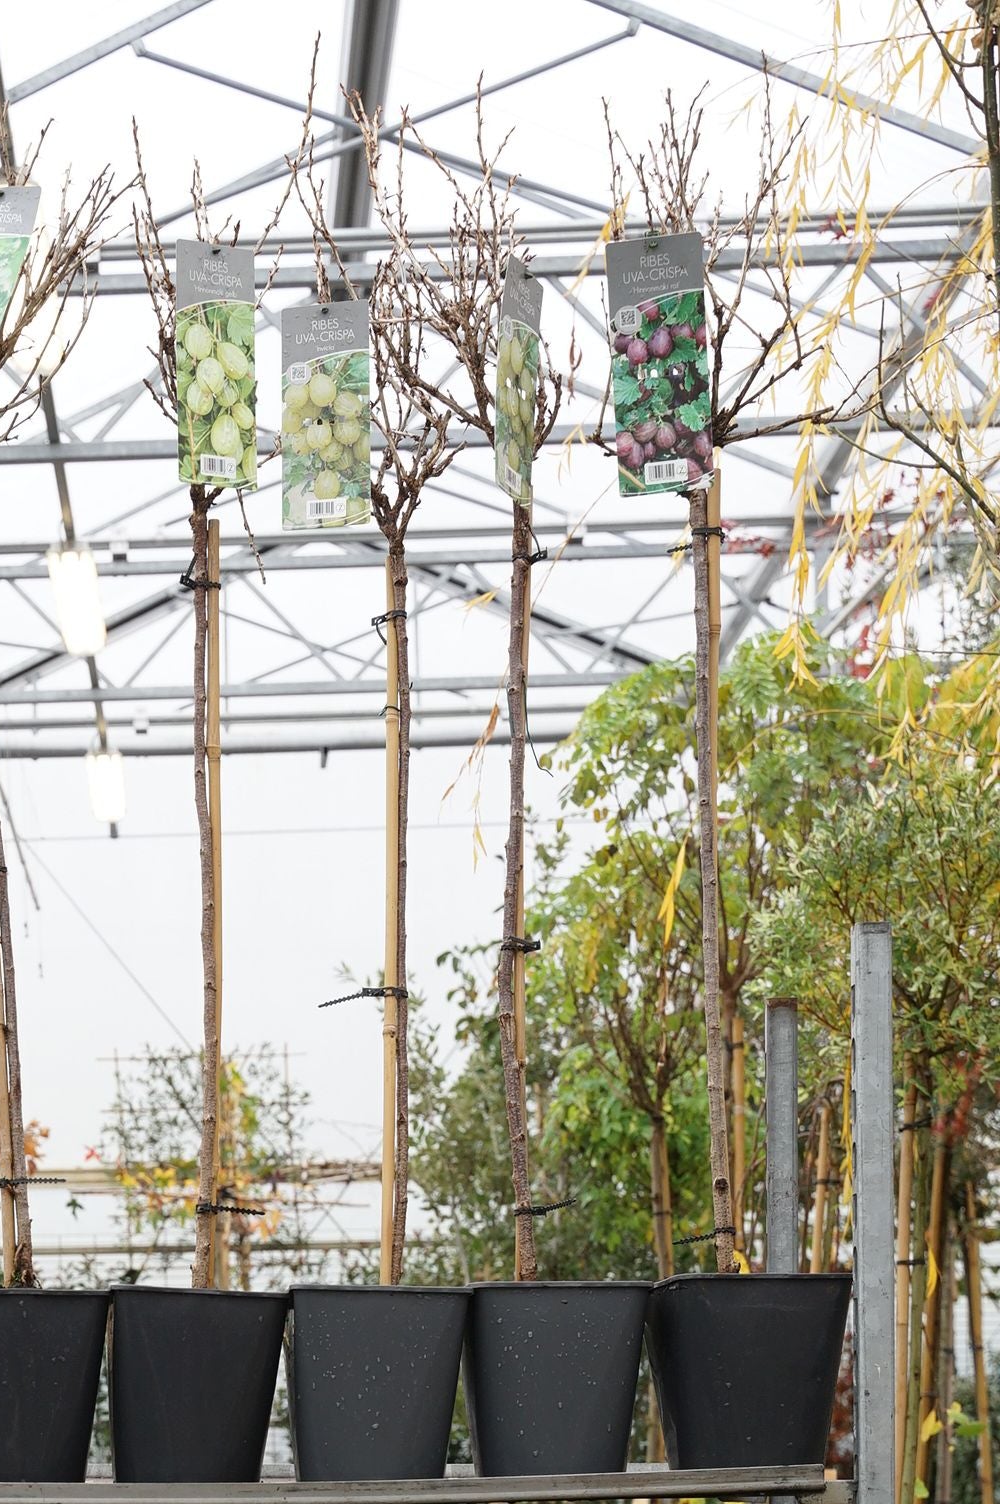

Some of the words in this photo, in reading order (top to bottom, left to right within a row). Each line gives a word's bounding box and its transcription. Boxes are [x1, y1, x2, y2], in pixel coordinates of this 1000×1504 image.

[203, 259, 228, 274] RIBES
[640, 253, 670, 268] RIBES
[189, 269, 243, 289] UVA-CRISPA
[622, 265, 689, 285] UVA-CRISPA
[311, 318, 339, 331] RIBES
[295, 329, 356, 345] UVA-CRISPA
